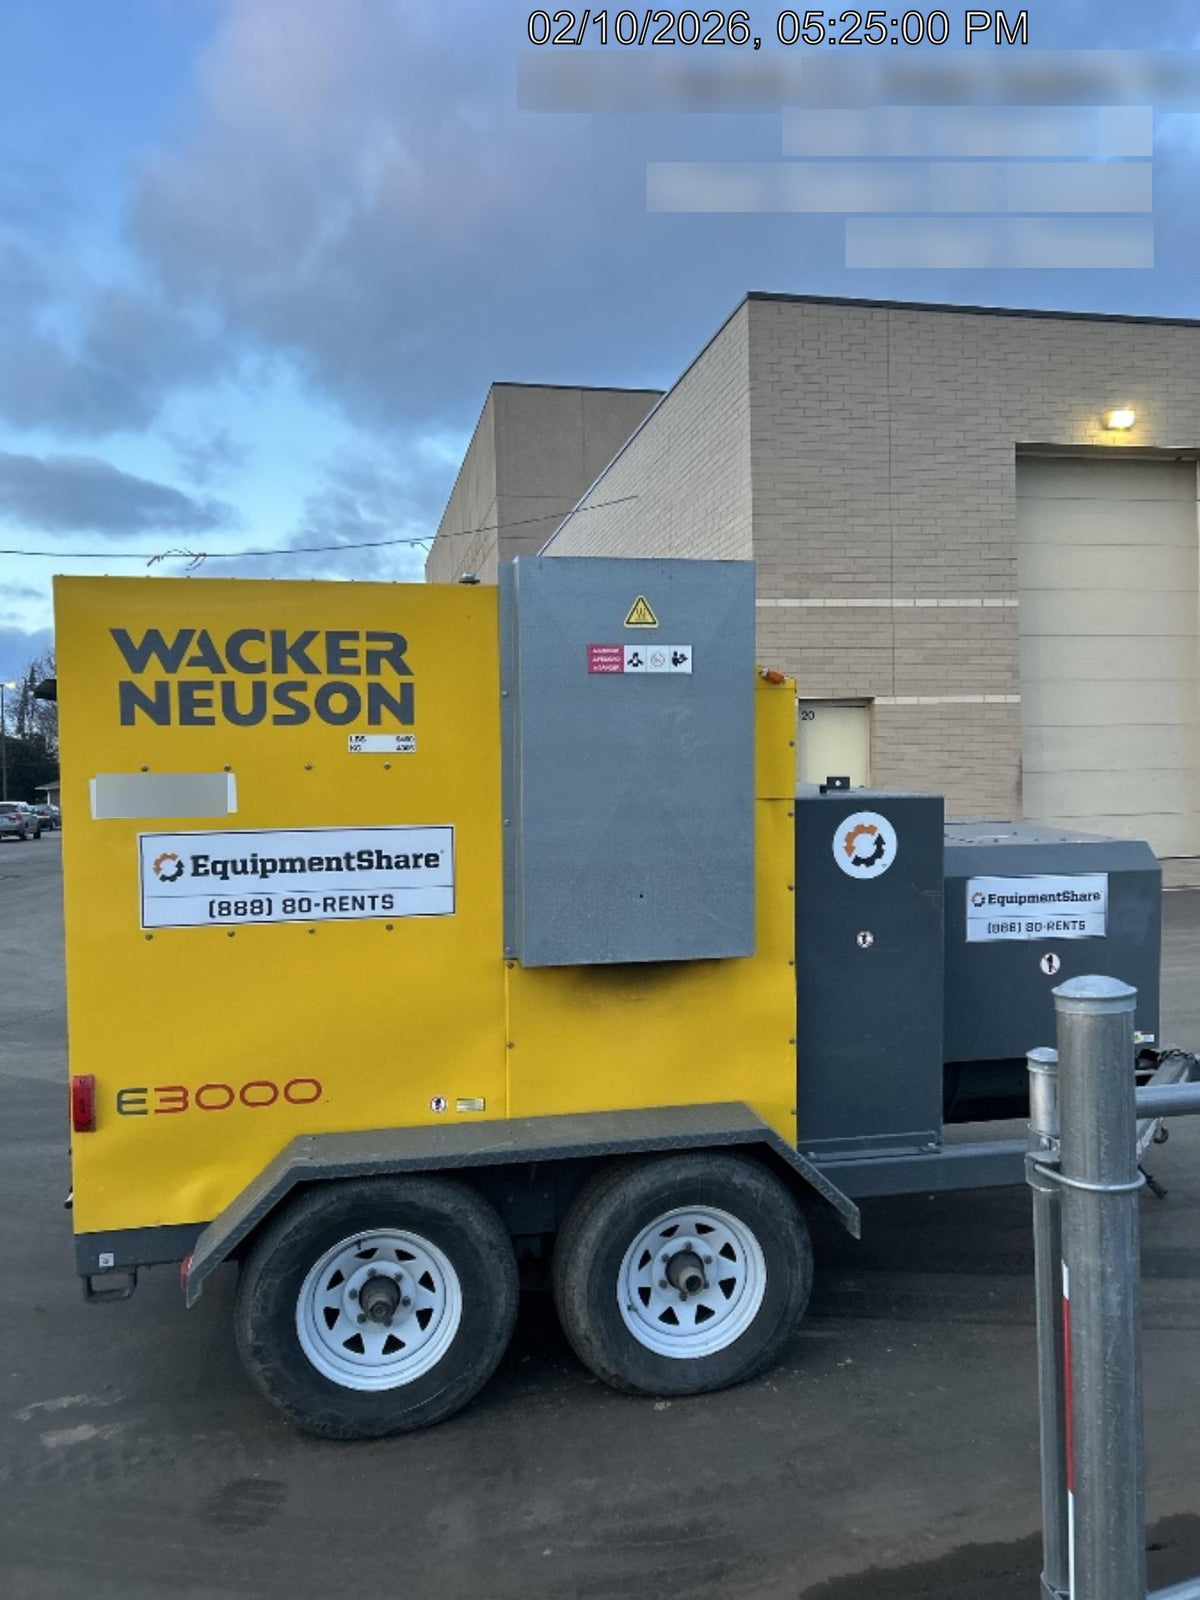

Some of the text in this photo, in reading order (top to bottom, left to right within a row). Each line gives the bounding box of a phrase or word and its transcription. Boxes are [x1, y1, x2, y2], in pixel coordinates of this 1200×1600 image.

[109, 628, 414, 676] WACKER
[119, 680, 415, 726] NEUSON
[801, 710, 815, 721] 20
[190, 850, 441, 881] EquipmentShare
[208, 894, 395, 919] (888) 80-RENTS
[988, 890, 1102, 907] EquipmentShare
[116, 1078, 322, 1116] E3000
